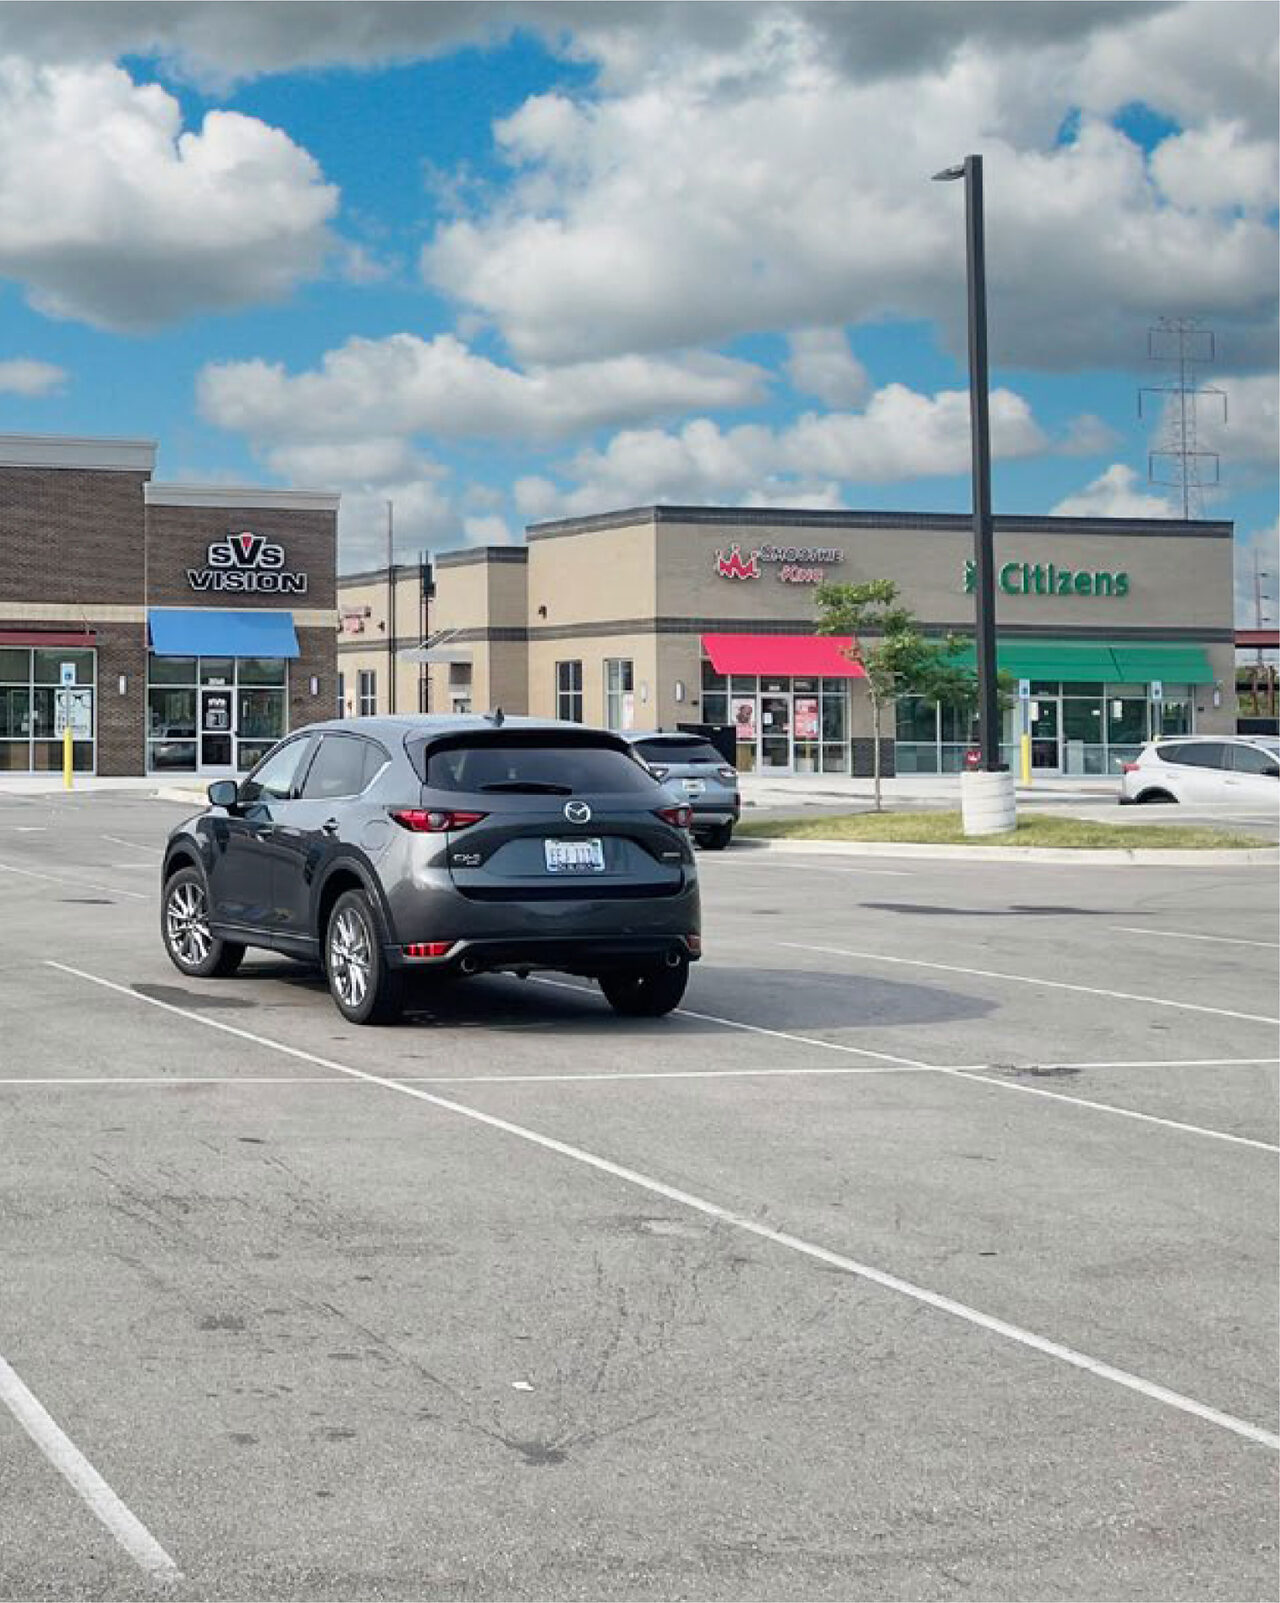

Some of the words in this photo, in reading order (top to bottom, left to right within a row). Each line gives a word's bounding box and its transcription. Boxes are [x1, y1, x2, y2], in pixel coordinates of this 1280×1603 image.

[208, 532, 285, 568] SVS
[187, 568, 308, 593] VISION
[998, 560, 1130, 597] Citizens
